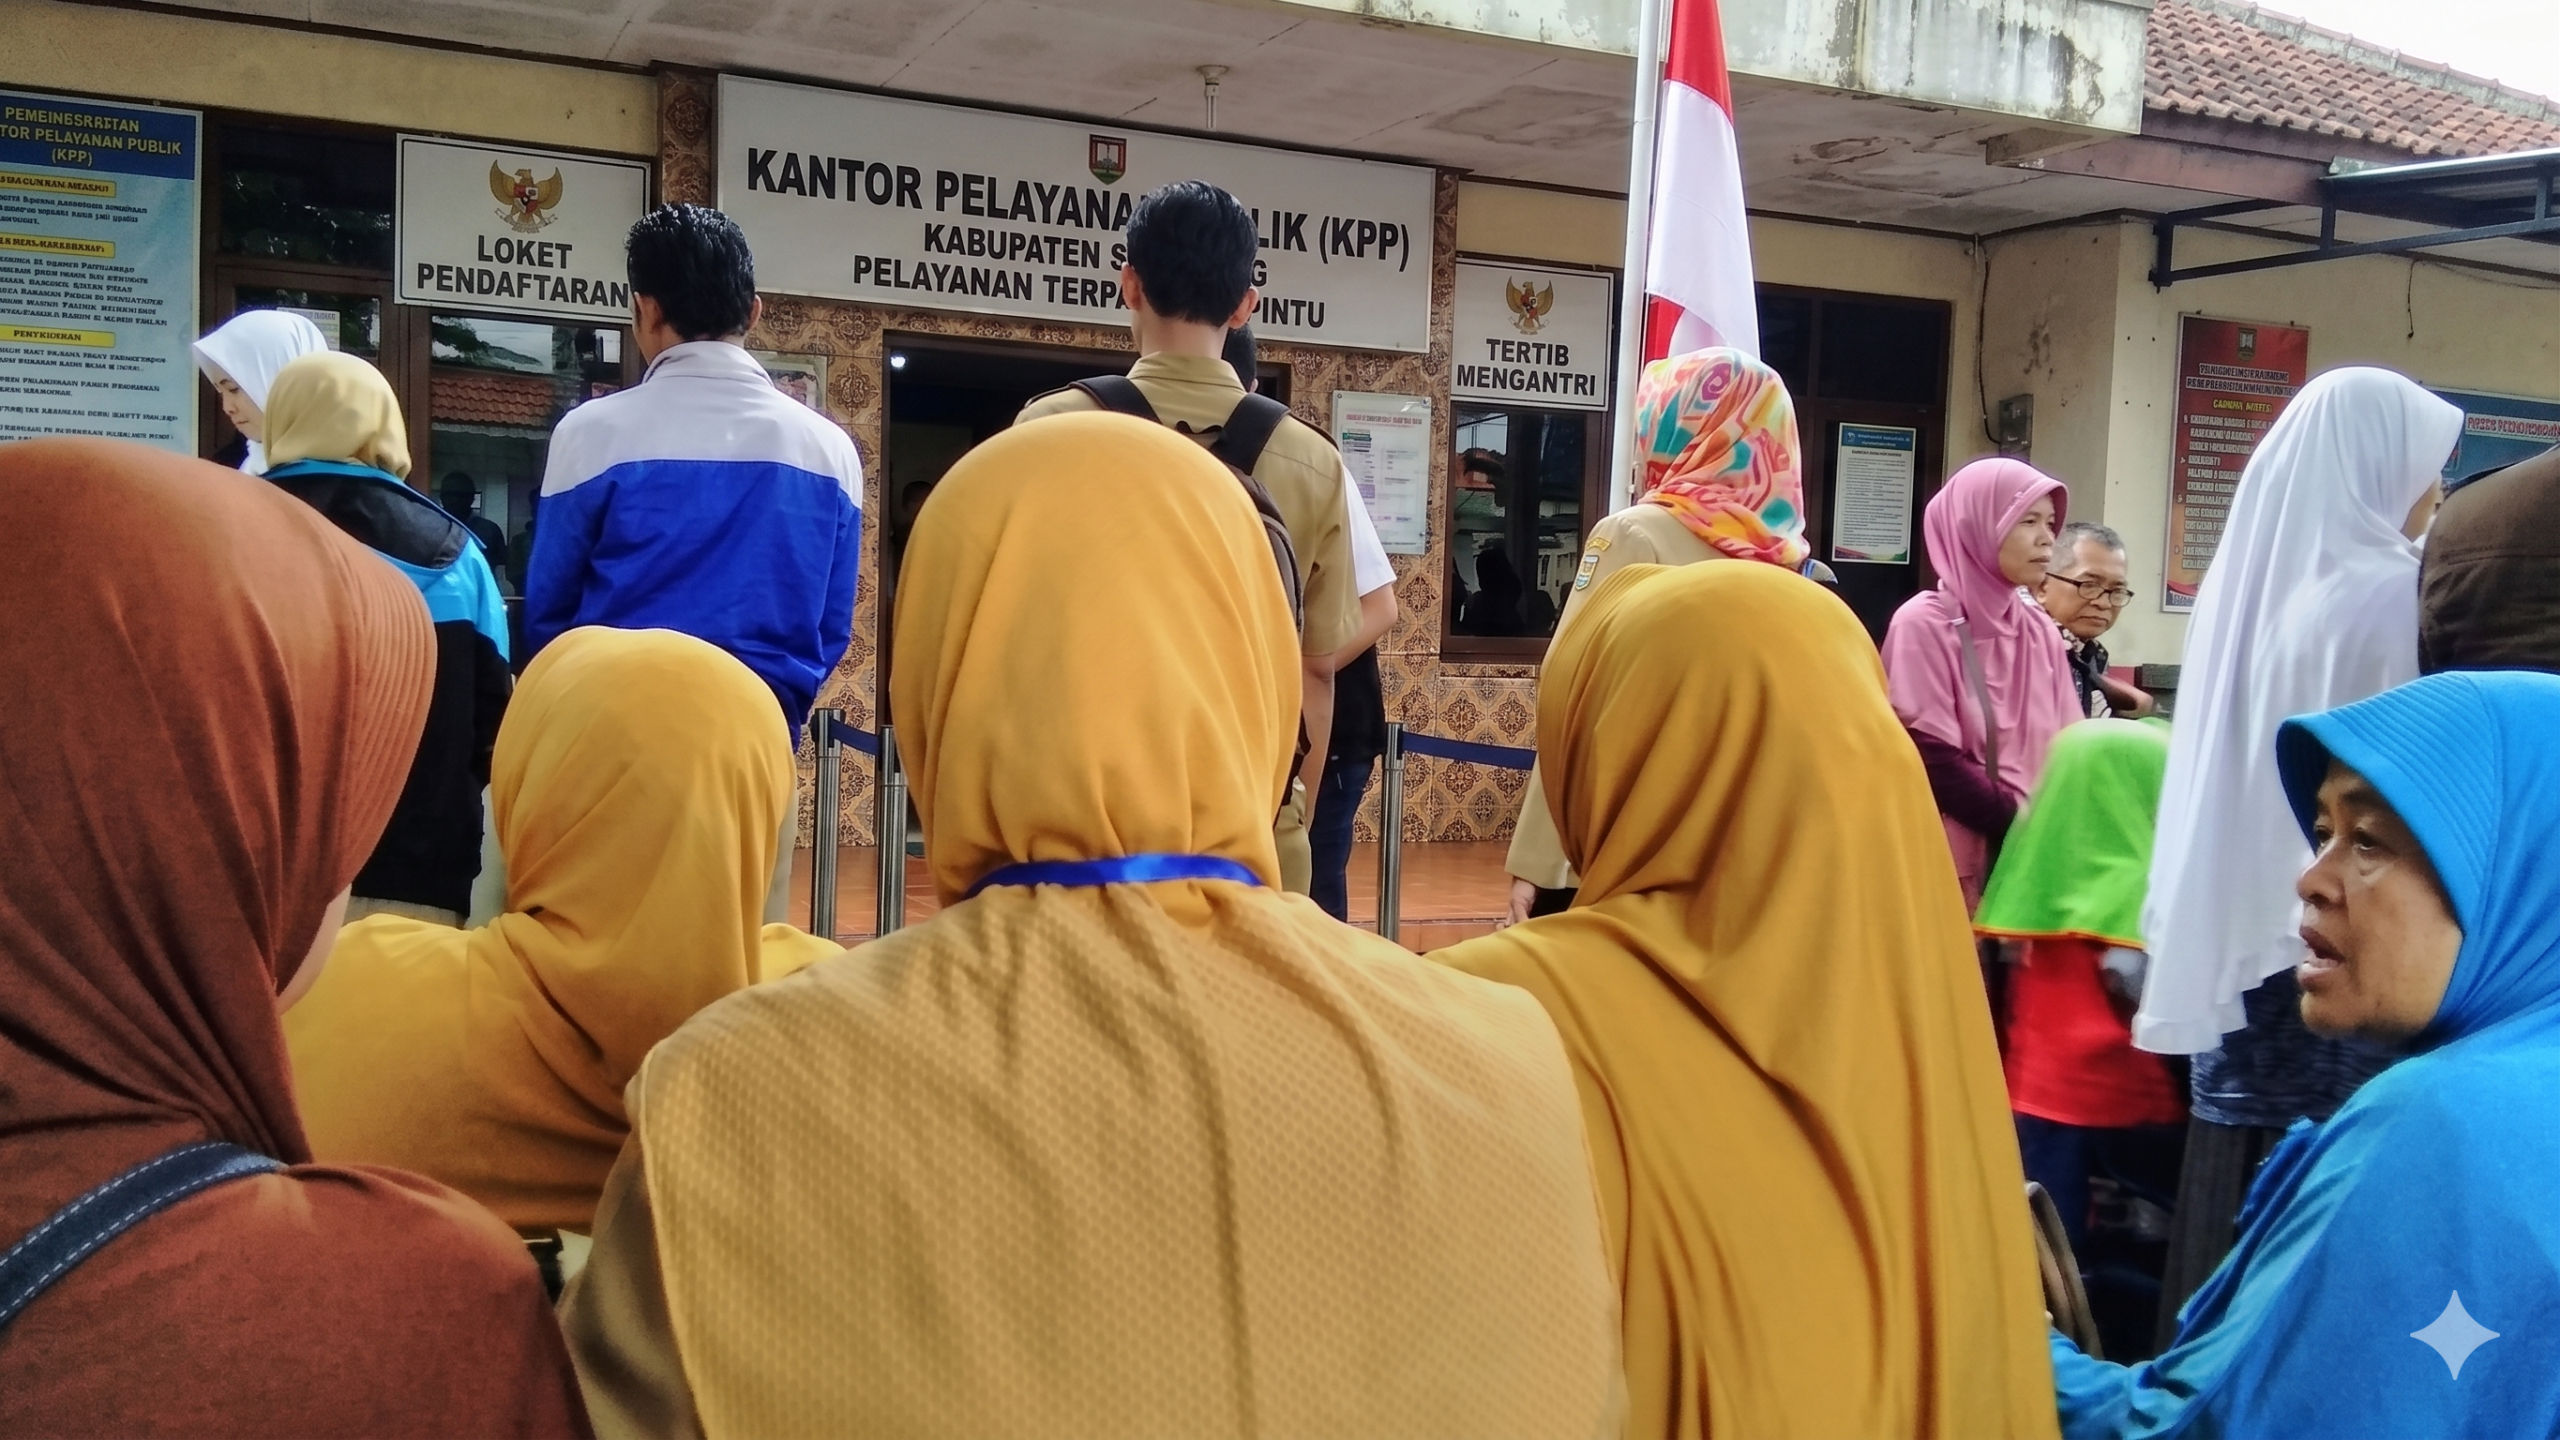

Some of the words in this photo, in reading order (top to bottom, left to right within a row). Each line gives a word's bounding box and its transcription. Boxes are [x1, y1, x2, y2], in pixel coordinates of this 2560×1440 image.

[35, 127, 123, 149] PELAYANAN
[127, 137, 182, 154] PUBLIK
[52, 148, 92, 167] (KPP)
[747, 147, 923, 210] KANTOR
[935, 169, 1148, 232] PELAYANA
[1250, 208, 1308, 253] LIK
[1319, 215, 1410, 272] (KPP)
[477, 235, 573, 270] LOKET
[924, 223, 1101, 269] KABUPATEN
[417, 263, 629, 309] PENDAFTARAN
[853, 254, 1033, 301] PELAYANAN
[1042, 274, 1130, 310] TERPA
[1485, 338, 1570, 367] TERTIB
[1456, 364, 1596, 397] MENGANTRI
